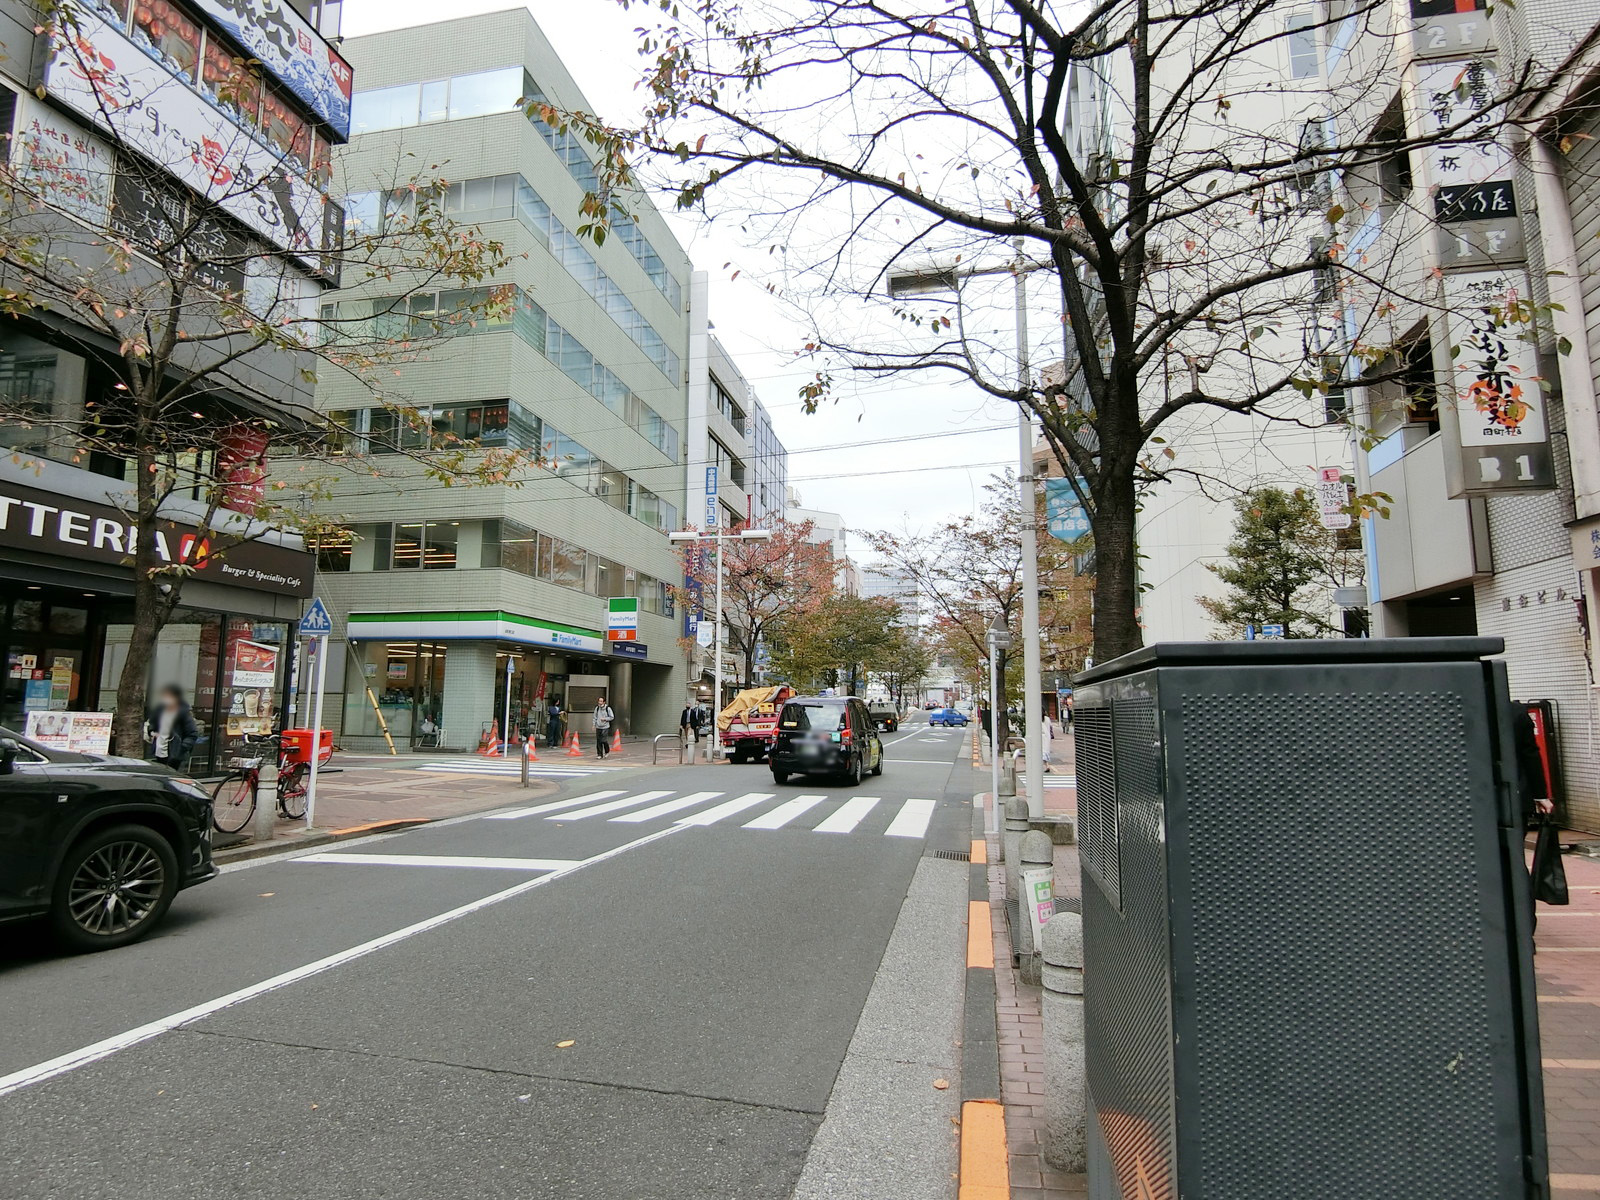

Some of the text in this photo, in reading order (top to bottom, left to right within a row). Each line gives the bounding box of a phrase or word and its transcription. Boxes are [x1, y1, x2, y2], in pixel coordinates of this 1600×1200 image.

[1427, 22, 1478, 48] 2F
[330, 61, 350, 82] 4F
[1455, 230, 1507, 257] 1F
[1478, 455, 1535, 482] B1
[706, 497, 716, 524] ena
[222, 564, 247, 577] Burger
[247, 569, 256, 577] &
[256, 571, 287, 586] Speciality
[610, 616, 636, 626] FamilyMart
[559, 634, 583, 646] FamilyMart
[618, 631, 627, 640] 酒
